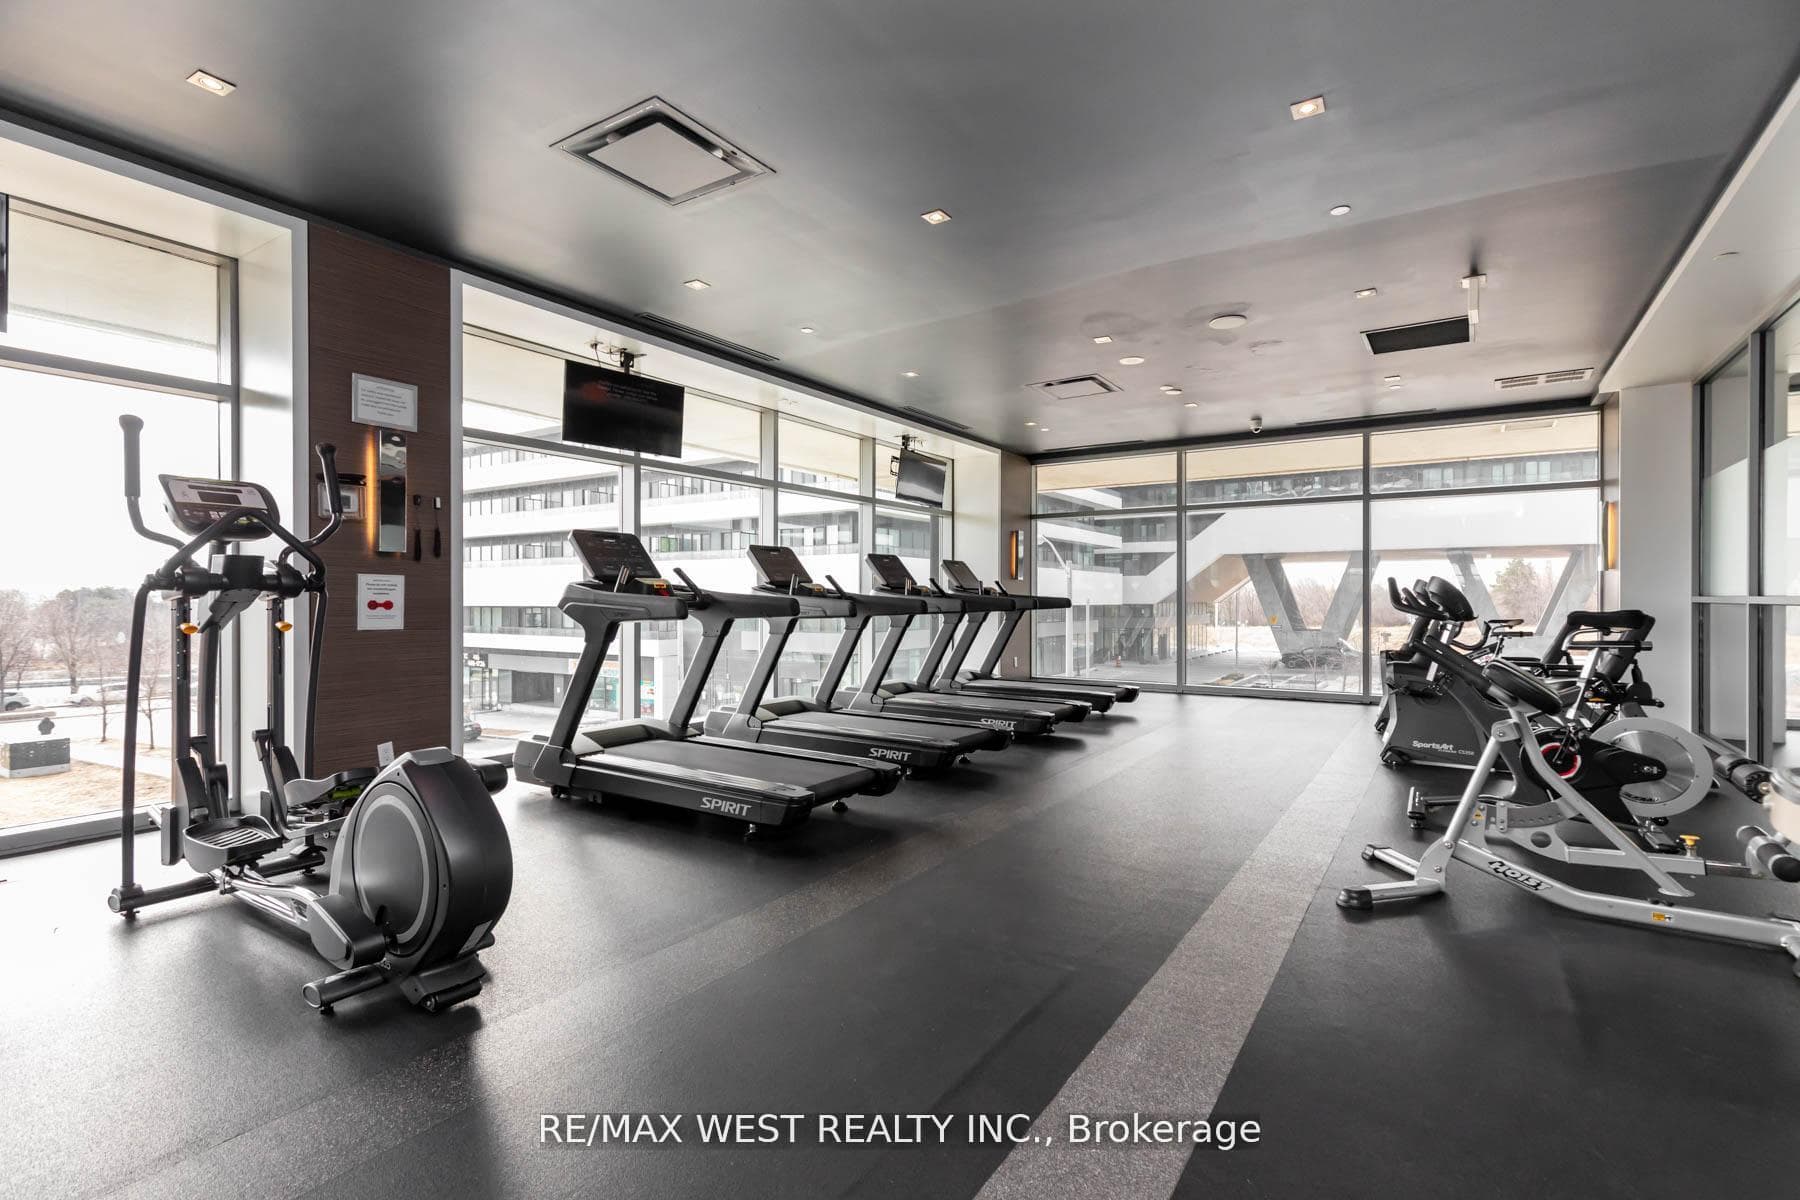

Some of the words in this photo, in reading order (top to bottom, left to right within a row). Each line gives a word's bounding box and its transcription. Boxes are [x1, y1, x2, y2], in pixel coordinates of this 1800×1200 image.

[1412, 740, 1454, 750] SportsArt
[869, 747, 912, 761] SPIRIT
[700, 797, 752, 816] SPIRIT
[1488, 860, 1553, 890] HOIST
